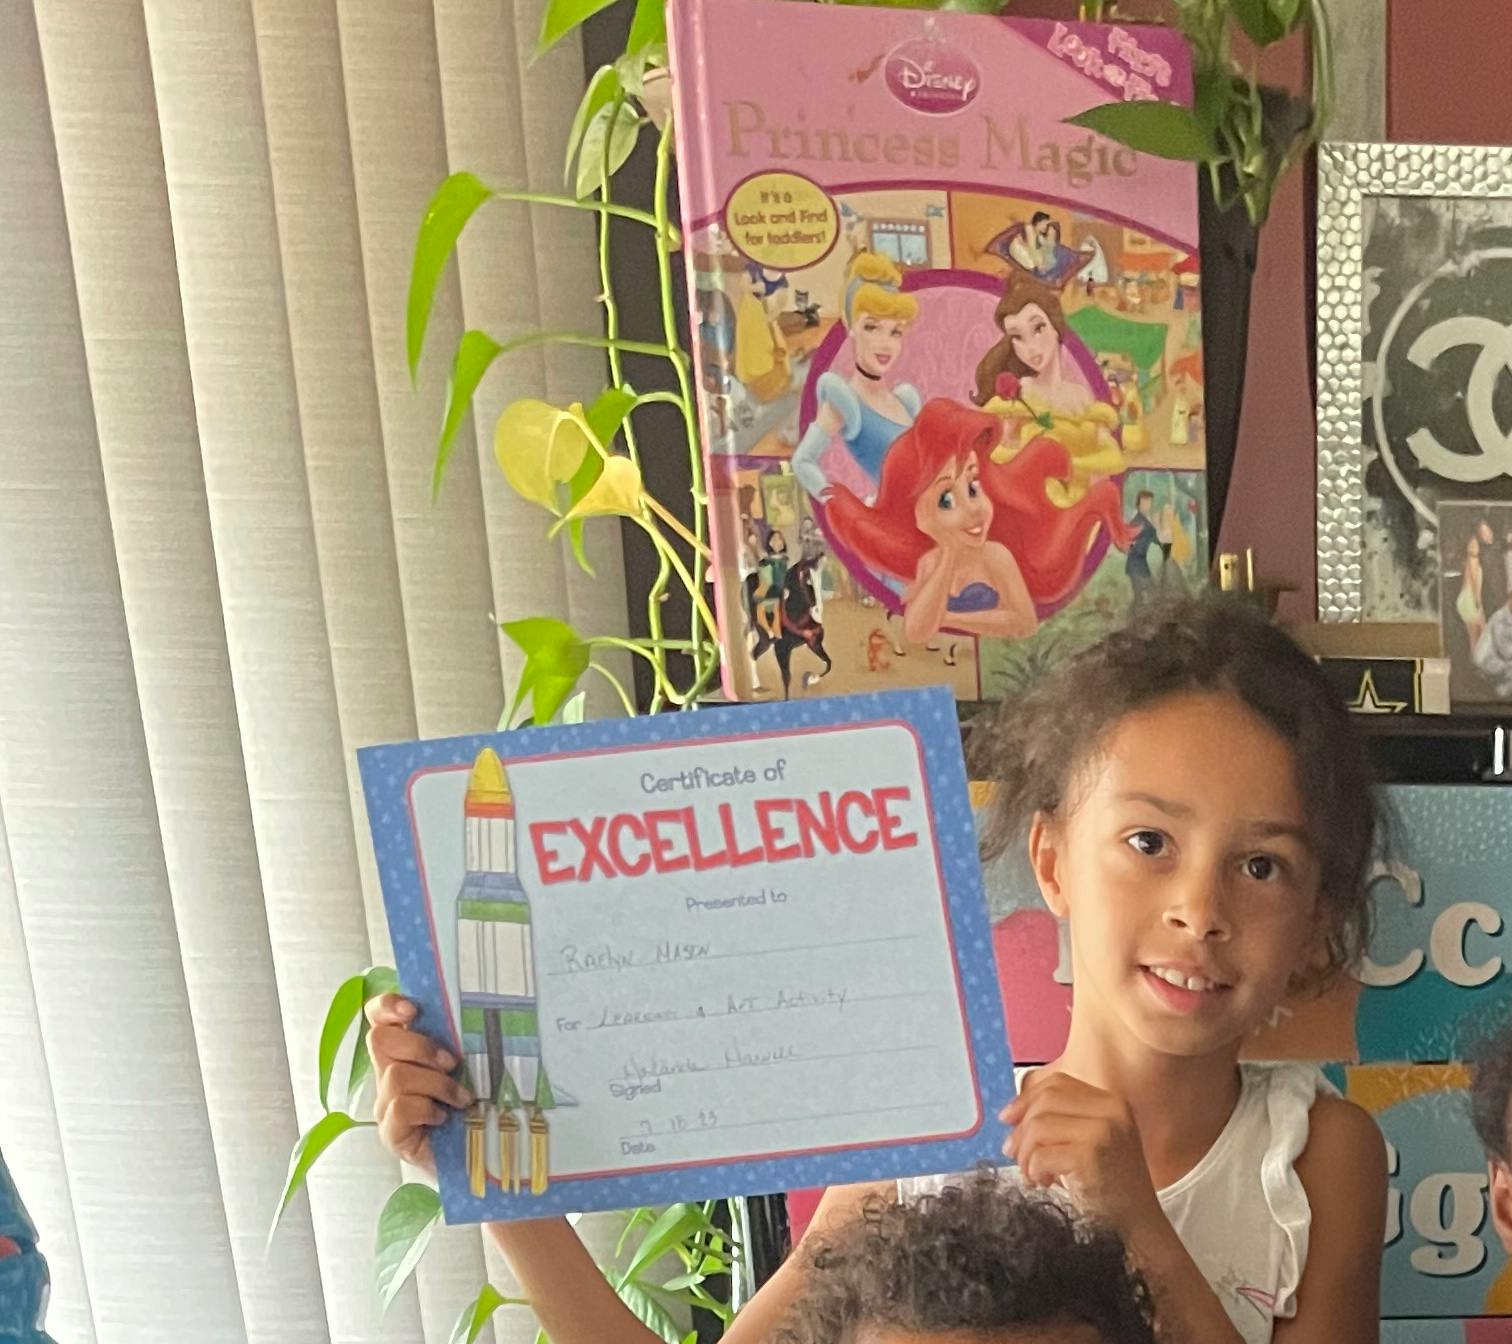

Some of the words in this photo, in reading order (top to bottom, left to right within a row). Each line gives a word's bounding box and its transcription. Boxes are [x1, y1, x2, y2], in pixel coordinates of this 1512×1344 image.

[722, 100, 961, 168] Princess
[980, 114, 1138, 189] Magic
[640, 766, 757, 794] Certificate
[763, 758, 787, 782] of
[528, 786, 919, 886] EXCELLENCE
[685, 889, 767, 912] Presented
[770, 890, 788, 904] to
[556, 1017, 583, 1032] For
[609, 1079, 663, 1101] Signed
[621, 1140, 656, 1157] Date
